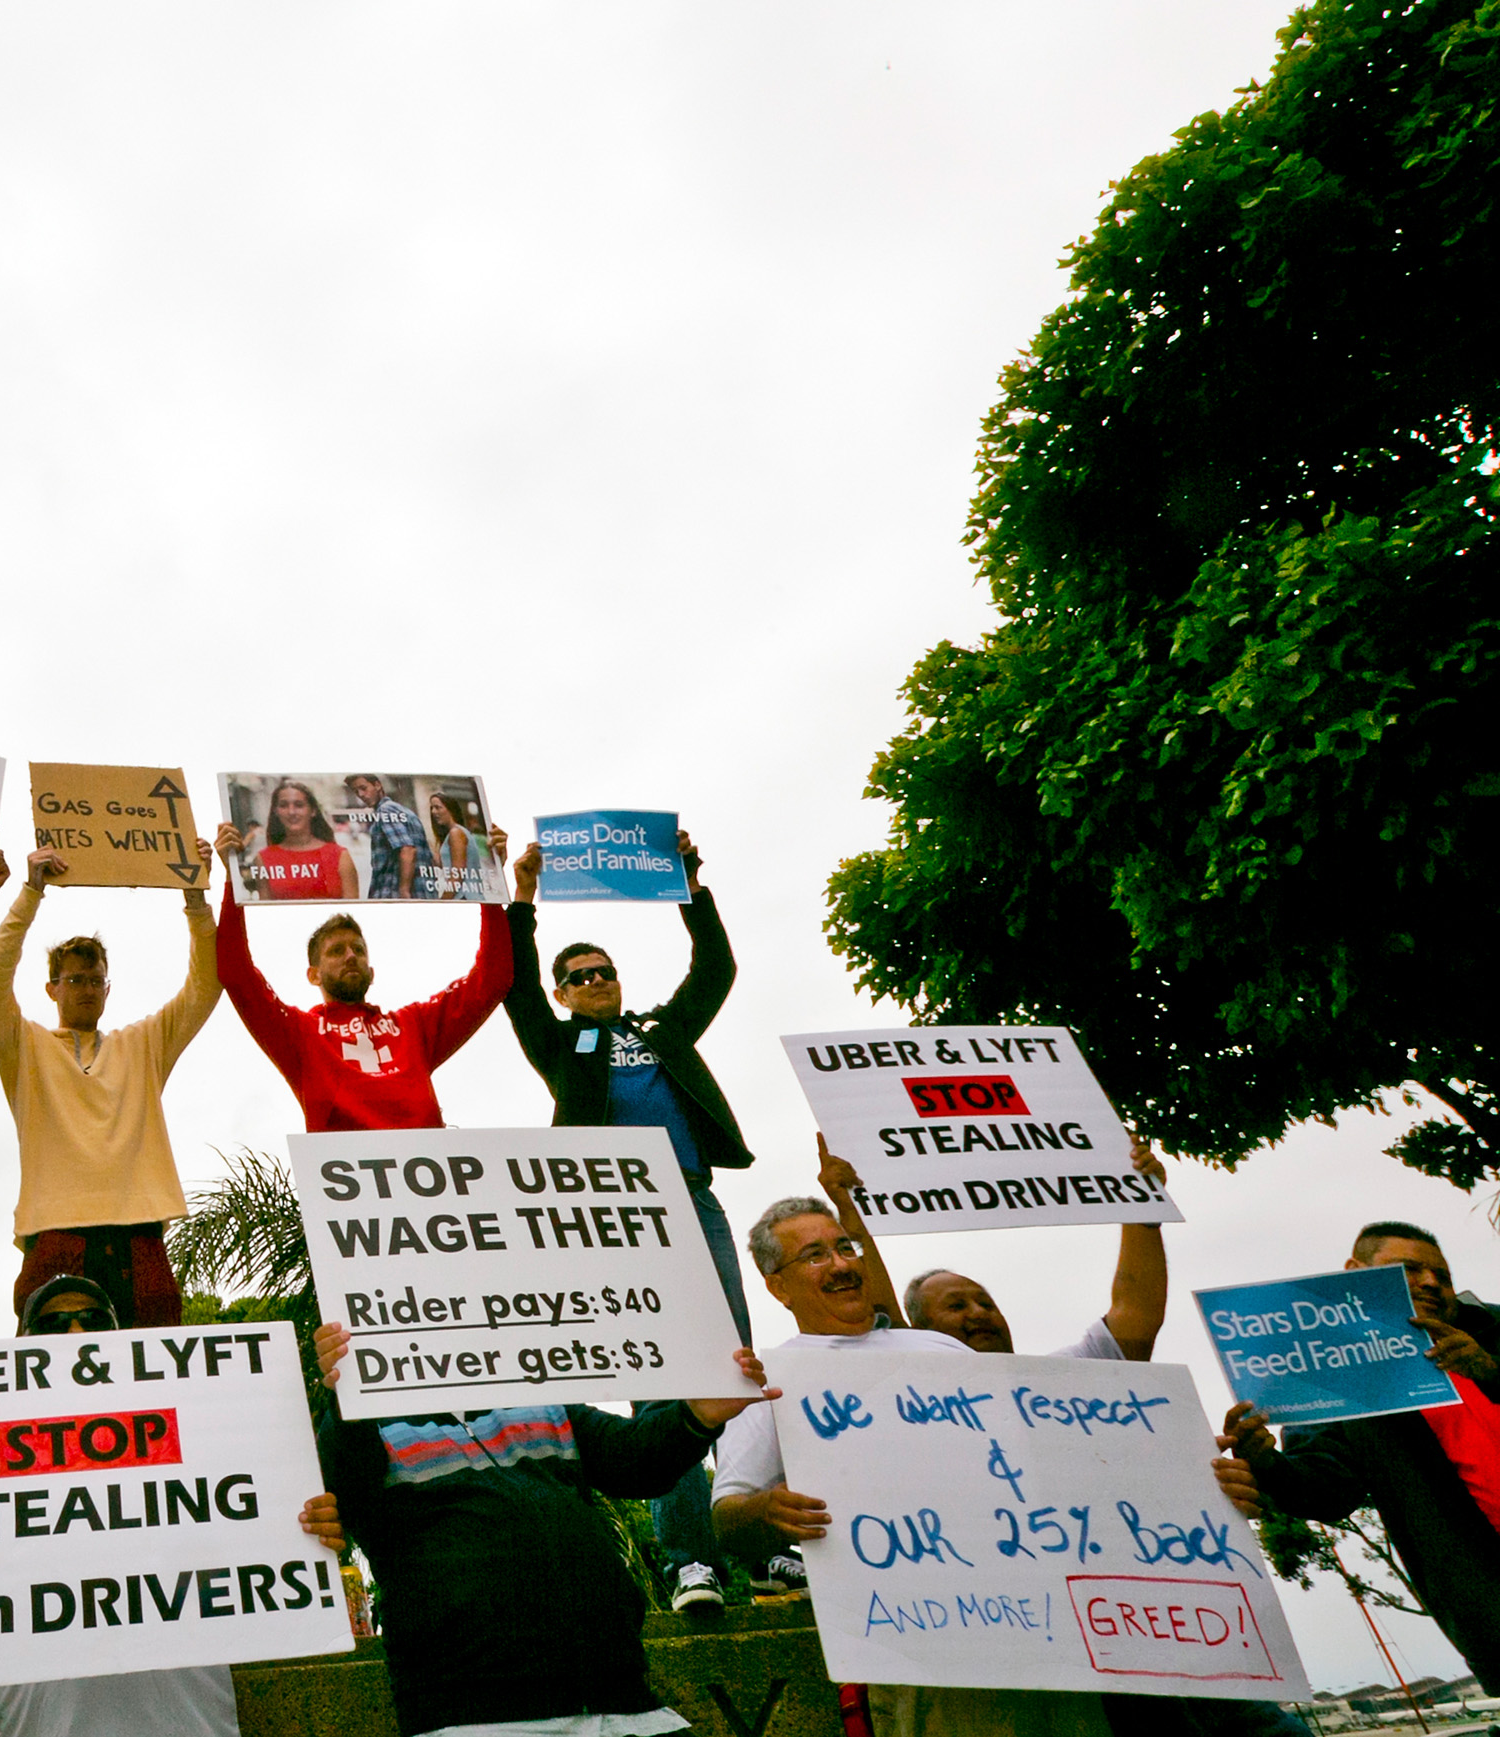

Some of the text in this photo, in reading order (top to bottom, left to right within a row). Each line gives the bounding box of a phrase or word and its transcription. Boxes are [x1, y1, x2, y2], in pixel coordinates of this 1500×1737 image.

[37, 792, 93, 816] GAS
[350, 812, 408, 823] DRIVERS
[35, 828, 92, 849] RATES
[541, 829, 590, 847] Stars
[250, 864, 319, 879] FAIR PAY
[419, 865, 494, 879] RIDESHARE
[542, 849, 673, 873] Feed Families
[806, 1038, 1061, 1072] UBER & LYFT
[910, 1082, 1017, 1112] STOP
[878, 1122, 1094, 1157] STEALING
[320, 1155, 660, 1201] STOP UBER
[853, 1173, 1165, 1216] from DRIVERS!
[327, 1206, 671, 1258] WAGE THEFT
[344, 1286, 466, 1327] Rider
[1211, 1308, 1293, 1341] Stars
[71, 1344, 115, 1386] &
[131, 1332, 270, 1382] LYFT
[355, 1342, 500, 1384] Driver
[1226, 1329, 1418, 1380] Feed Families
[1013, 1386, 1170, 1435] respect
[5, 1412, 167, 1471] STOP
[850, 1508, 974, 1569] OUR
[994, 1505, 1102, 1563] 25%
[30, 1559, 335, 1635] DRIVERS!
[1087, 1597, 1249, 1648] GREED!
